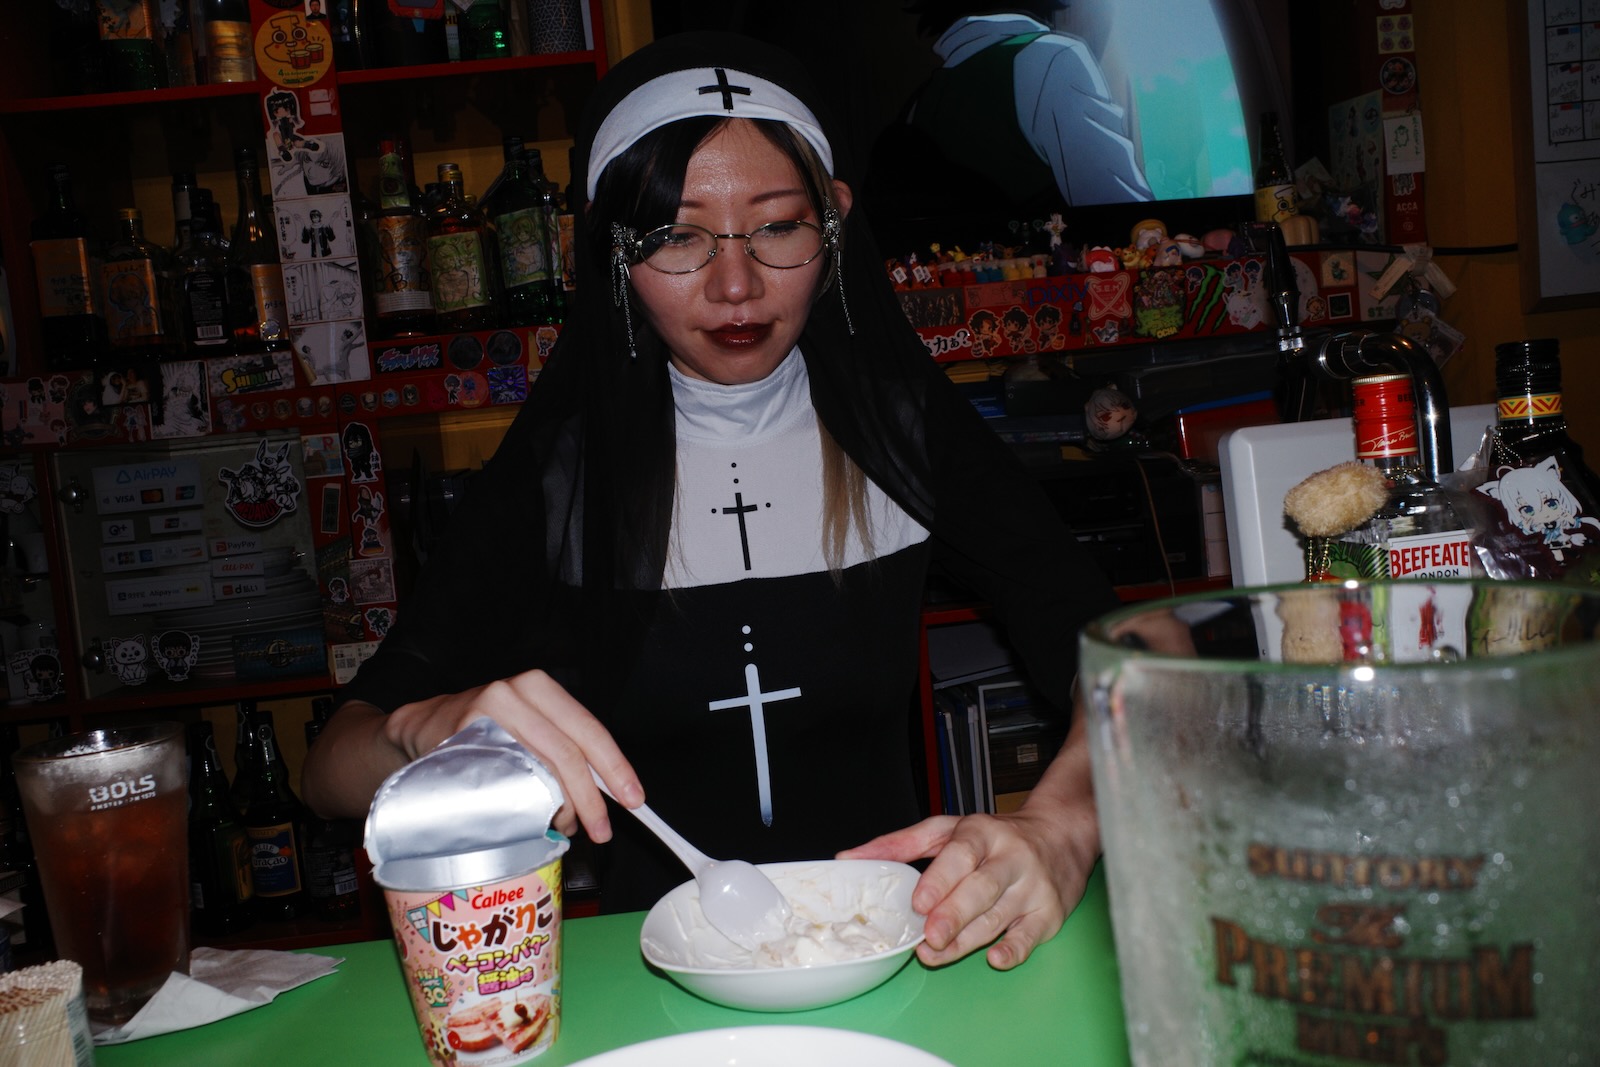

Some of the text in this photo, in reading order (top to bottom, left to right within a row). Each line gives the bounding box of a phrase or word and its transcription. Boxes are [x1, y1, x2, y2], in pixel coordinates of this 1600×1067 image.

[1396, 201, 1418, 212] ACCA
[1026, 278, 1089, 308] pixiv
[221, 368, 282, 394] SHIRUYA
[133, 466, 177, 481] AirPAY
[115, 495, 135, 504] VISA
[227, 540, 256, 550] PayPay
[239, 561, 255, 571] PAY
[1390, 541, 1469, 580] BEEFEATE
[1414, 568, 1459, 580] LONDON
[88, 773, 156, 803] BOLS
[1247, 841, 1484, 891] SUNTORY
[472, 887, 524, 910] Calbee
[432, 893, 553, 951] じゃがりこ
[446, 934, 550, 973] ベーコンバター
[1211, 915, 1535, 1021] PREMIUM
[423, 986, 447, 1004] 30
